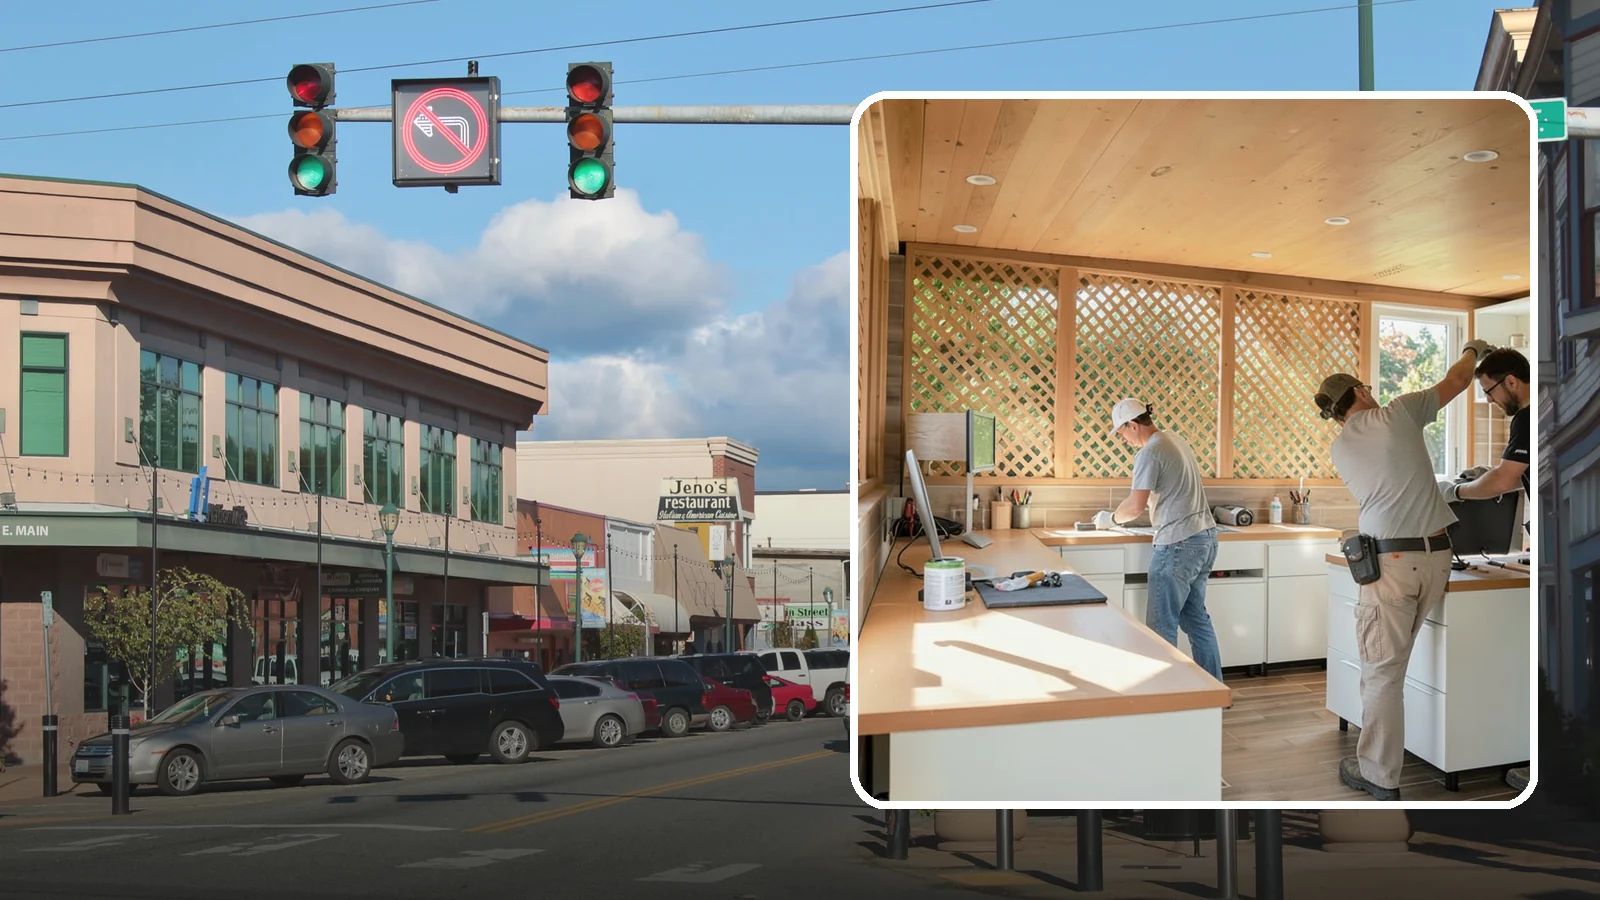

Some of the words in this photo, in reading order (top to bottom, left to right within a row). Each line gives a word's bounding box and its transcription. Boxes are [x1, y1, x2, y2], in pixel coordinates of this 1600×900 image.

[669, 480, 728, 494] Jeno's
[665, 496, 731, 509] restaurant
[658, 510, 681, 519] Italian
[685, 509, 714, 519] American
[714, 509, 738, 519] Cuisine
[2, 525, 13, 536] E.
[15, 525, 49, 536] MAIN
[797, 607, 828, 617] Street
[790, 619, 824, 627] lass
